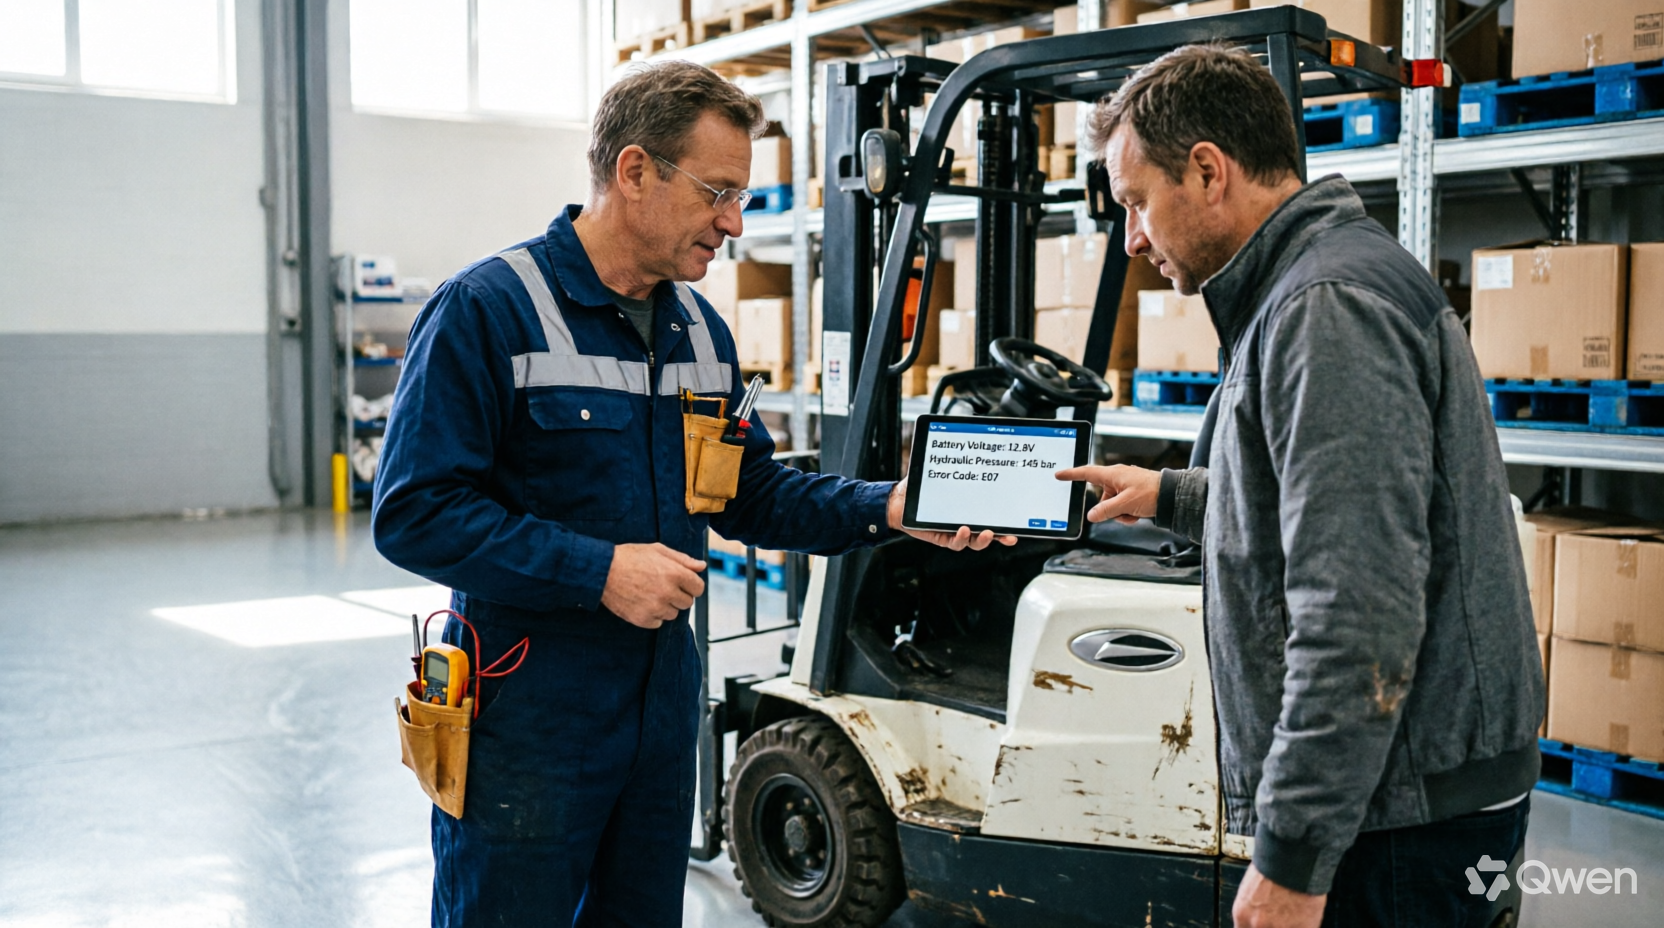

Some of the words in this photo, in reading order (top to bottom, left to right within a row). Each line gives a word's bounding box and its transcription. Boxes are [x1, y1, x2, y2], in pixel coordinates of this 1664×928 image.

[931, 439, 965, 451] Battery
[967, 441, 1005, 452] Voltage:
[1008, 443, 1035, 453] 12.8V
[929, 454, 973, 465] Hydraulic
[975, 456, 1018, 467] Pressure:
[1040, 460, 1056, 469] bar
[928, 470, 951, 480] Error
[952, 471, 979, 481] Code:
[981, 473, 999, 482] E07
